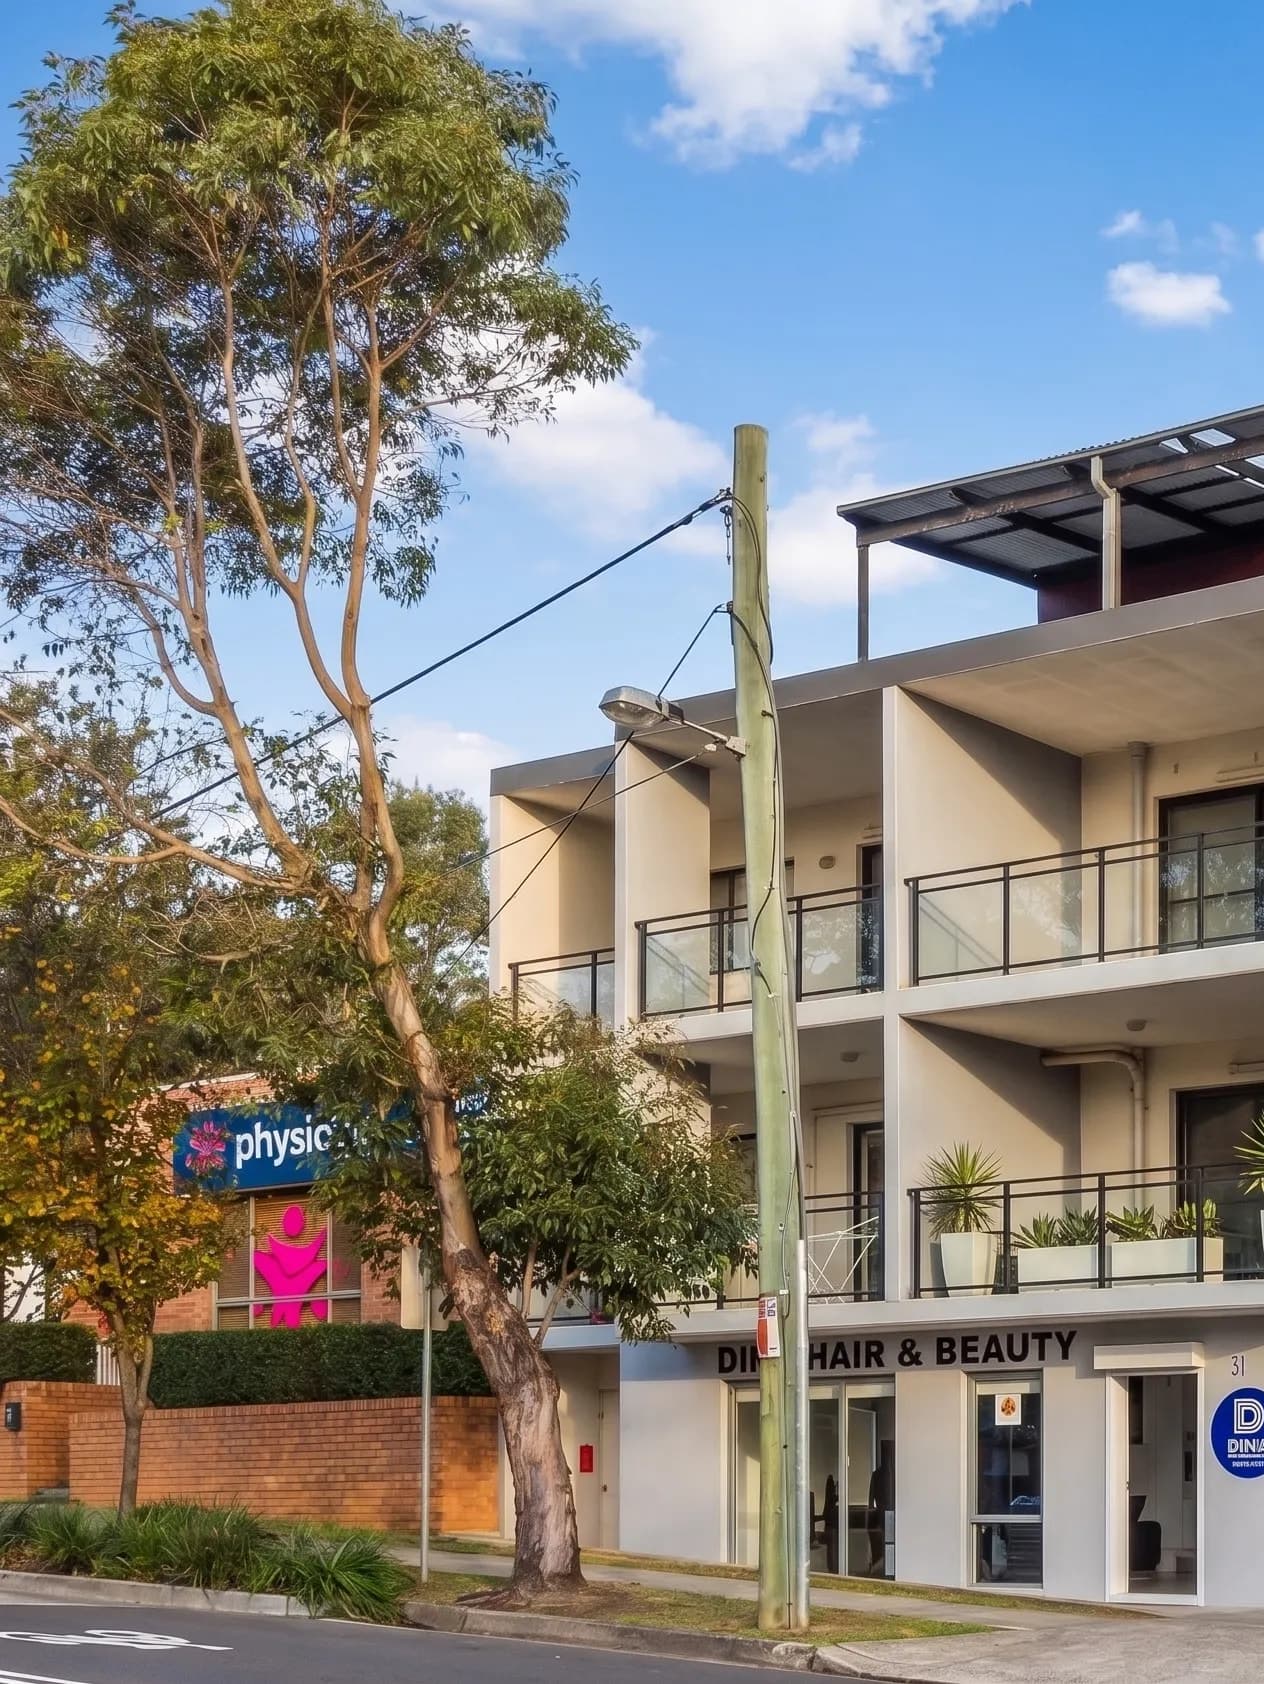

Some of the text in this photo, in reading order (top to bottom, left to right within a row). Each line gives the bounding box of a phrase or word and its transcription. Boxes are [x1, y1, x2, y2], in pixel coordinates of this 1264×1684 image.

[808, 1340, 885, 1370] HAIR
[898, 1338, 923, 1367] &
[936, 1330, 1078, 1366] BEAUTY
[1231, 1354, 1245, 1377] 31
[1233, 1398, 1264, 1434] D
